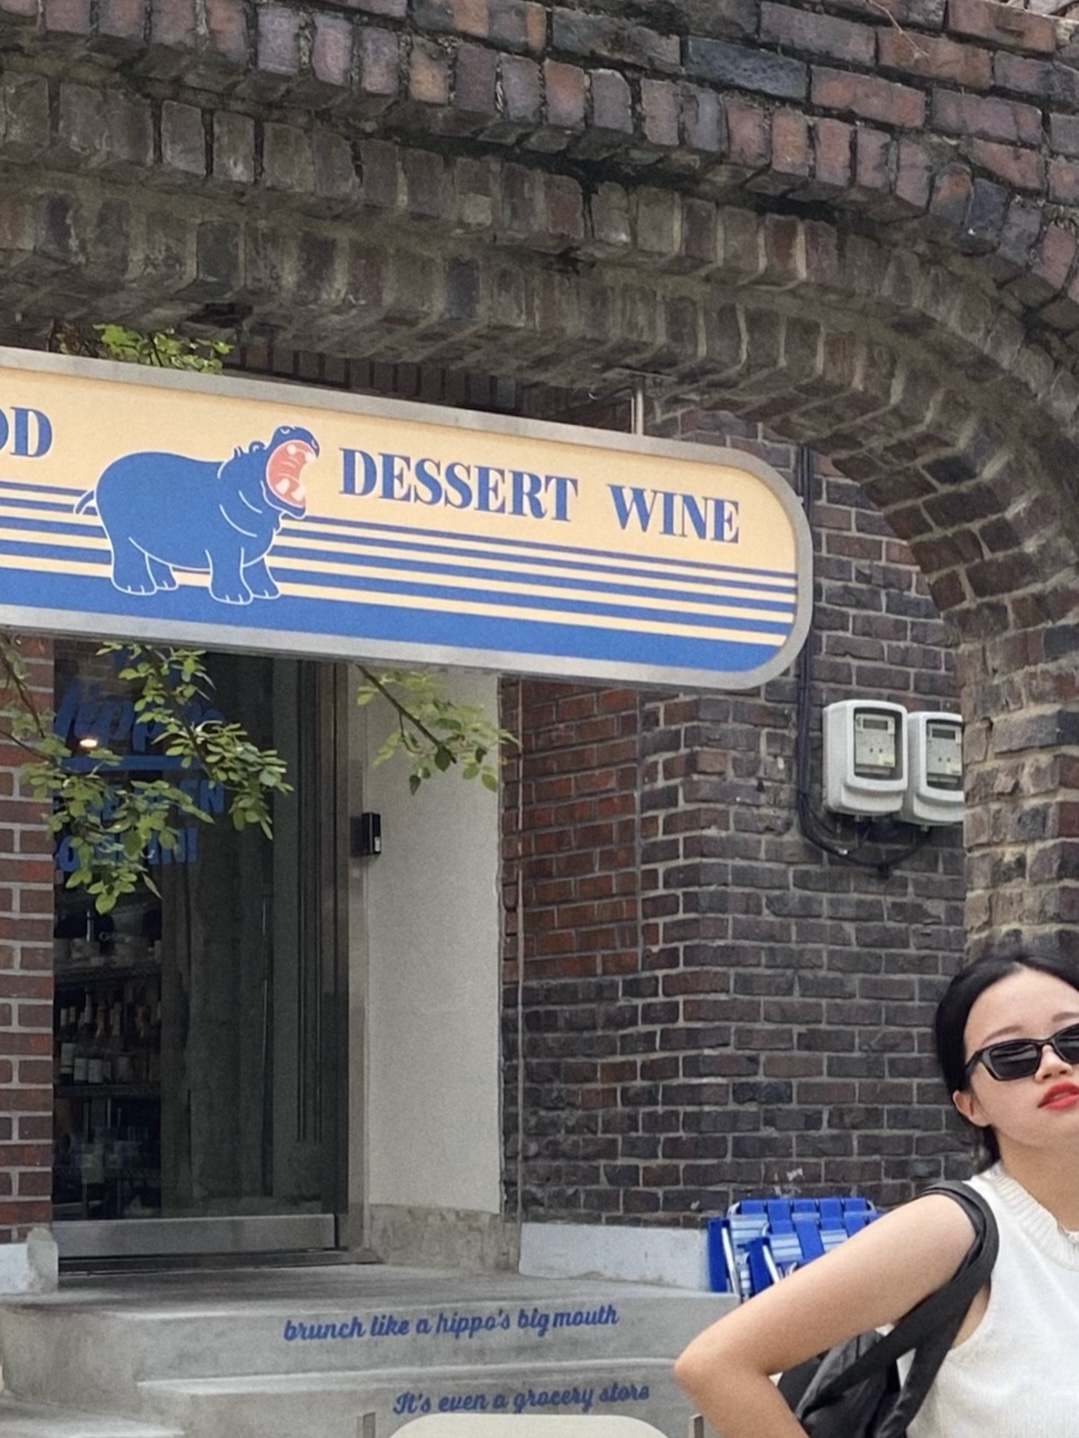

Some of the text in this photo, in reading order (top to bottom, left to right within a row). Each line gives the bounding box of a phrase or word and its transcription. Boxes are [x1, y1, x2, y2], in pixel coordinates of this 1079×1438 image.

[0, 405, 53, 458] D
[339, 447, 739, 544] DESSERT WINE
[284, 1305, 620, 1342] brunch like a hippo's big mouth
[393, 1381, 650, 1414] It's even a grocery store
